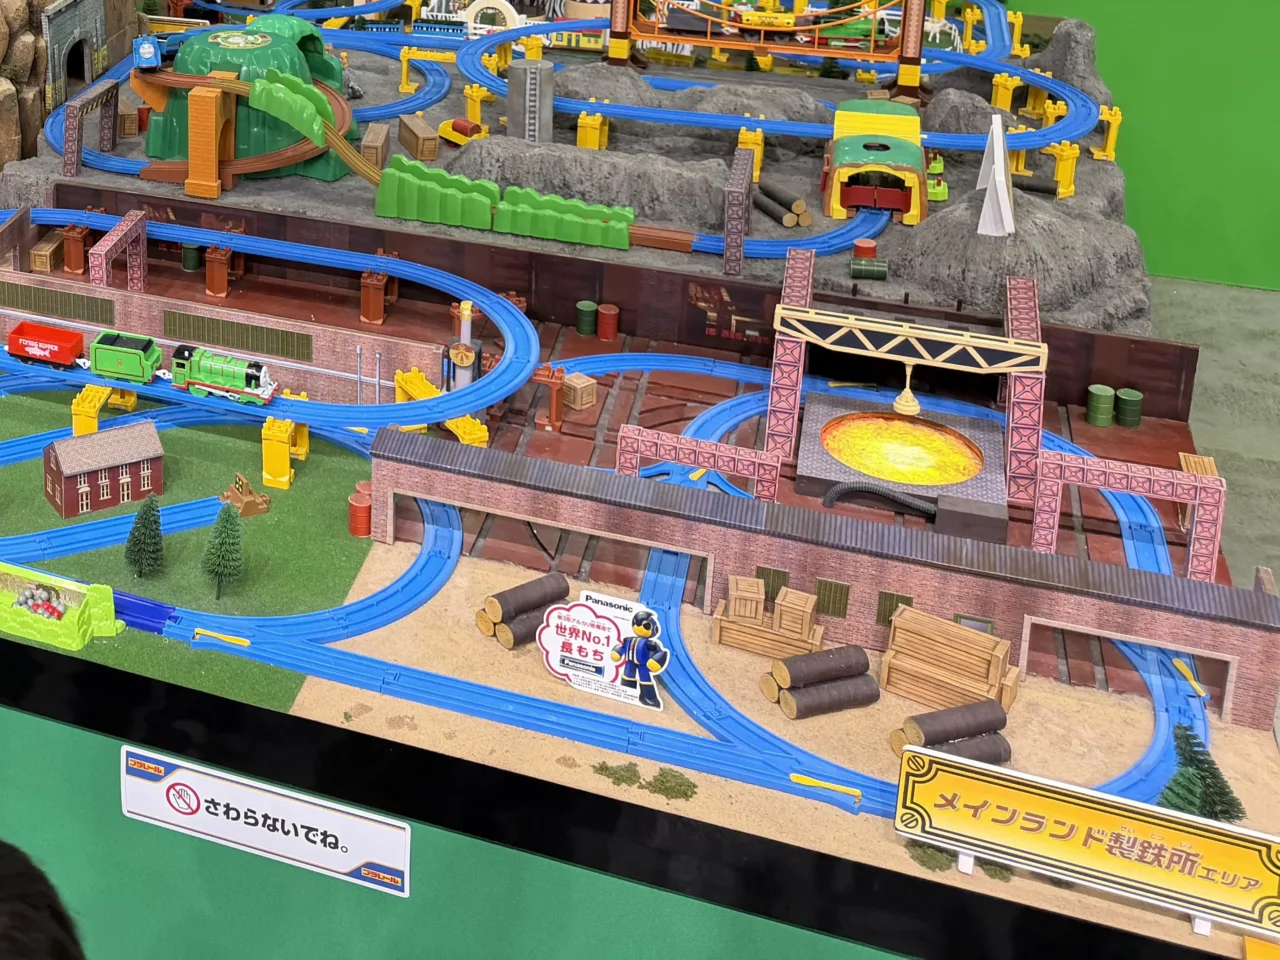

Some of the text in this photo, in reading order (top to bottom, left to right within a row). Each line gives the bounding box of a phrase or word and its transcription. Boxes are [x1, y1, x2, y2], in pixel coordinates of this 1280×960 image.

[585, 594, 634, 613] Panasonic
[555, 622, 611, 648] 世界No.1
[128, 758, 163, 775] プラレール
[204, 798, 349, 854] さわらないでね。
[933, 791, 1263, 891] メインランド製鉄所エリア
[361, 868, 401, 885] プラレール
